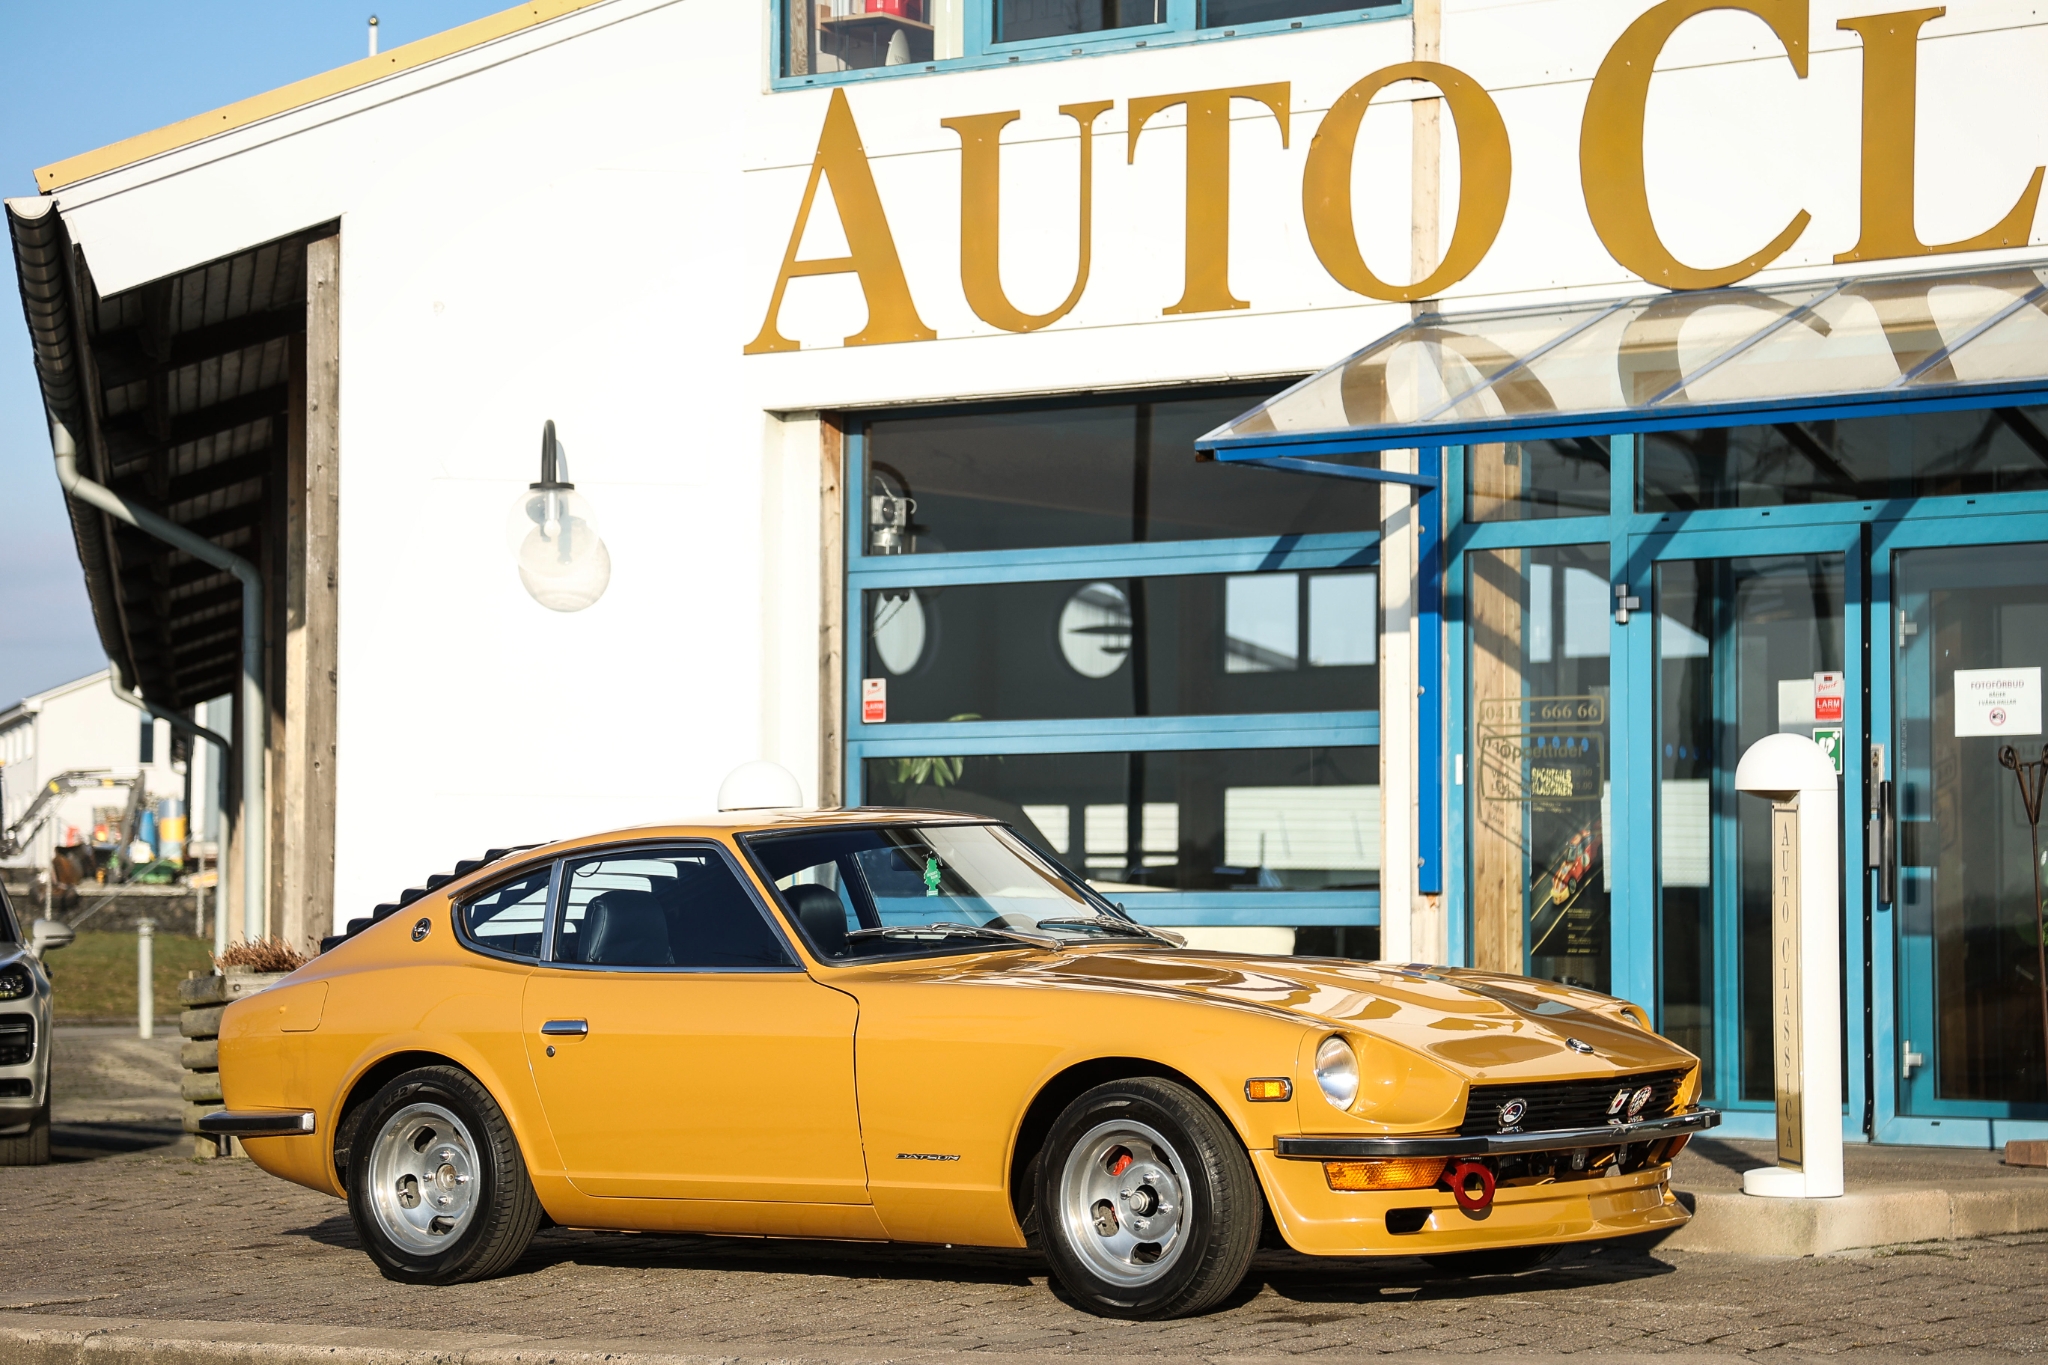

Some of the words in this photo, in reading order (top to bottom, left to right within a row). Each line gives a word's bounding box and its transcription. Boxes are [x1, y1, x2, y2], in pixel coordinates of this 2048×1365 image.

[742, 60, 1512, 355] AUTO
[1579, 0, 2046, 290] CL
[1970, 679, 2025, 690] FOTOFÖRBUD
[1485, 706, 1521, 721] 0411
[1541, 704, 1573, 719] 666
[1578, 703, 1598, 718] 66
[1816, 699, 1840, 709] LARM
[1781, 820, 1790, 924] AUTO
[1781, 936, 1794, 1149] CLASSICA
[896, 1153, 960, 1162] DATSUN
